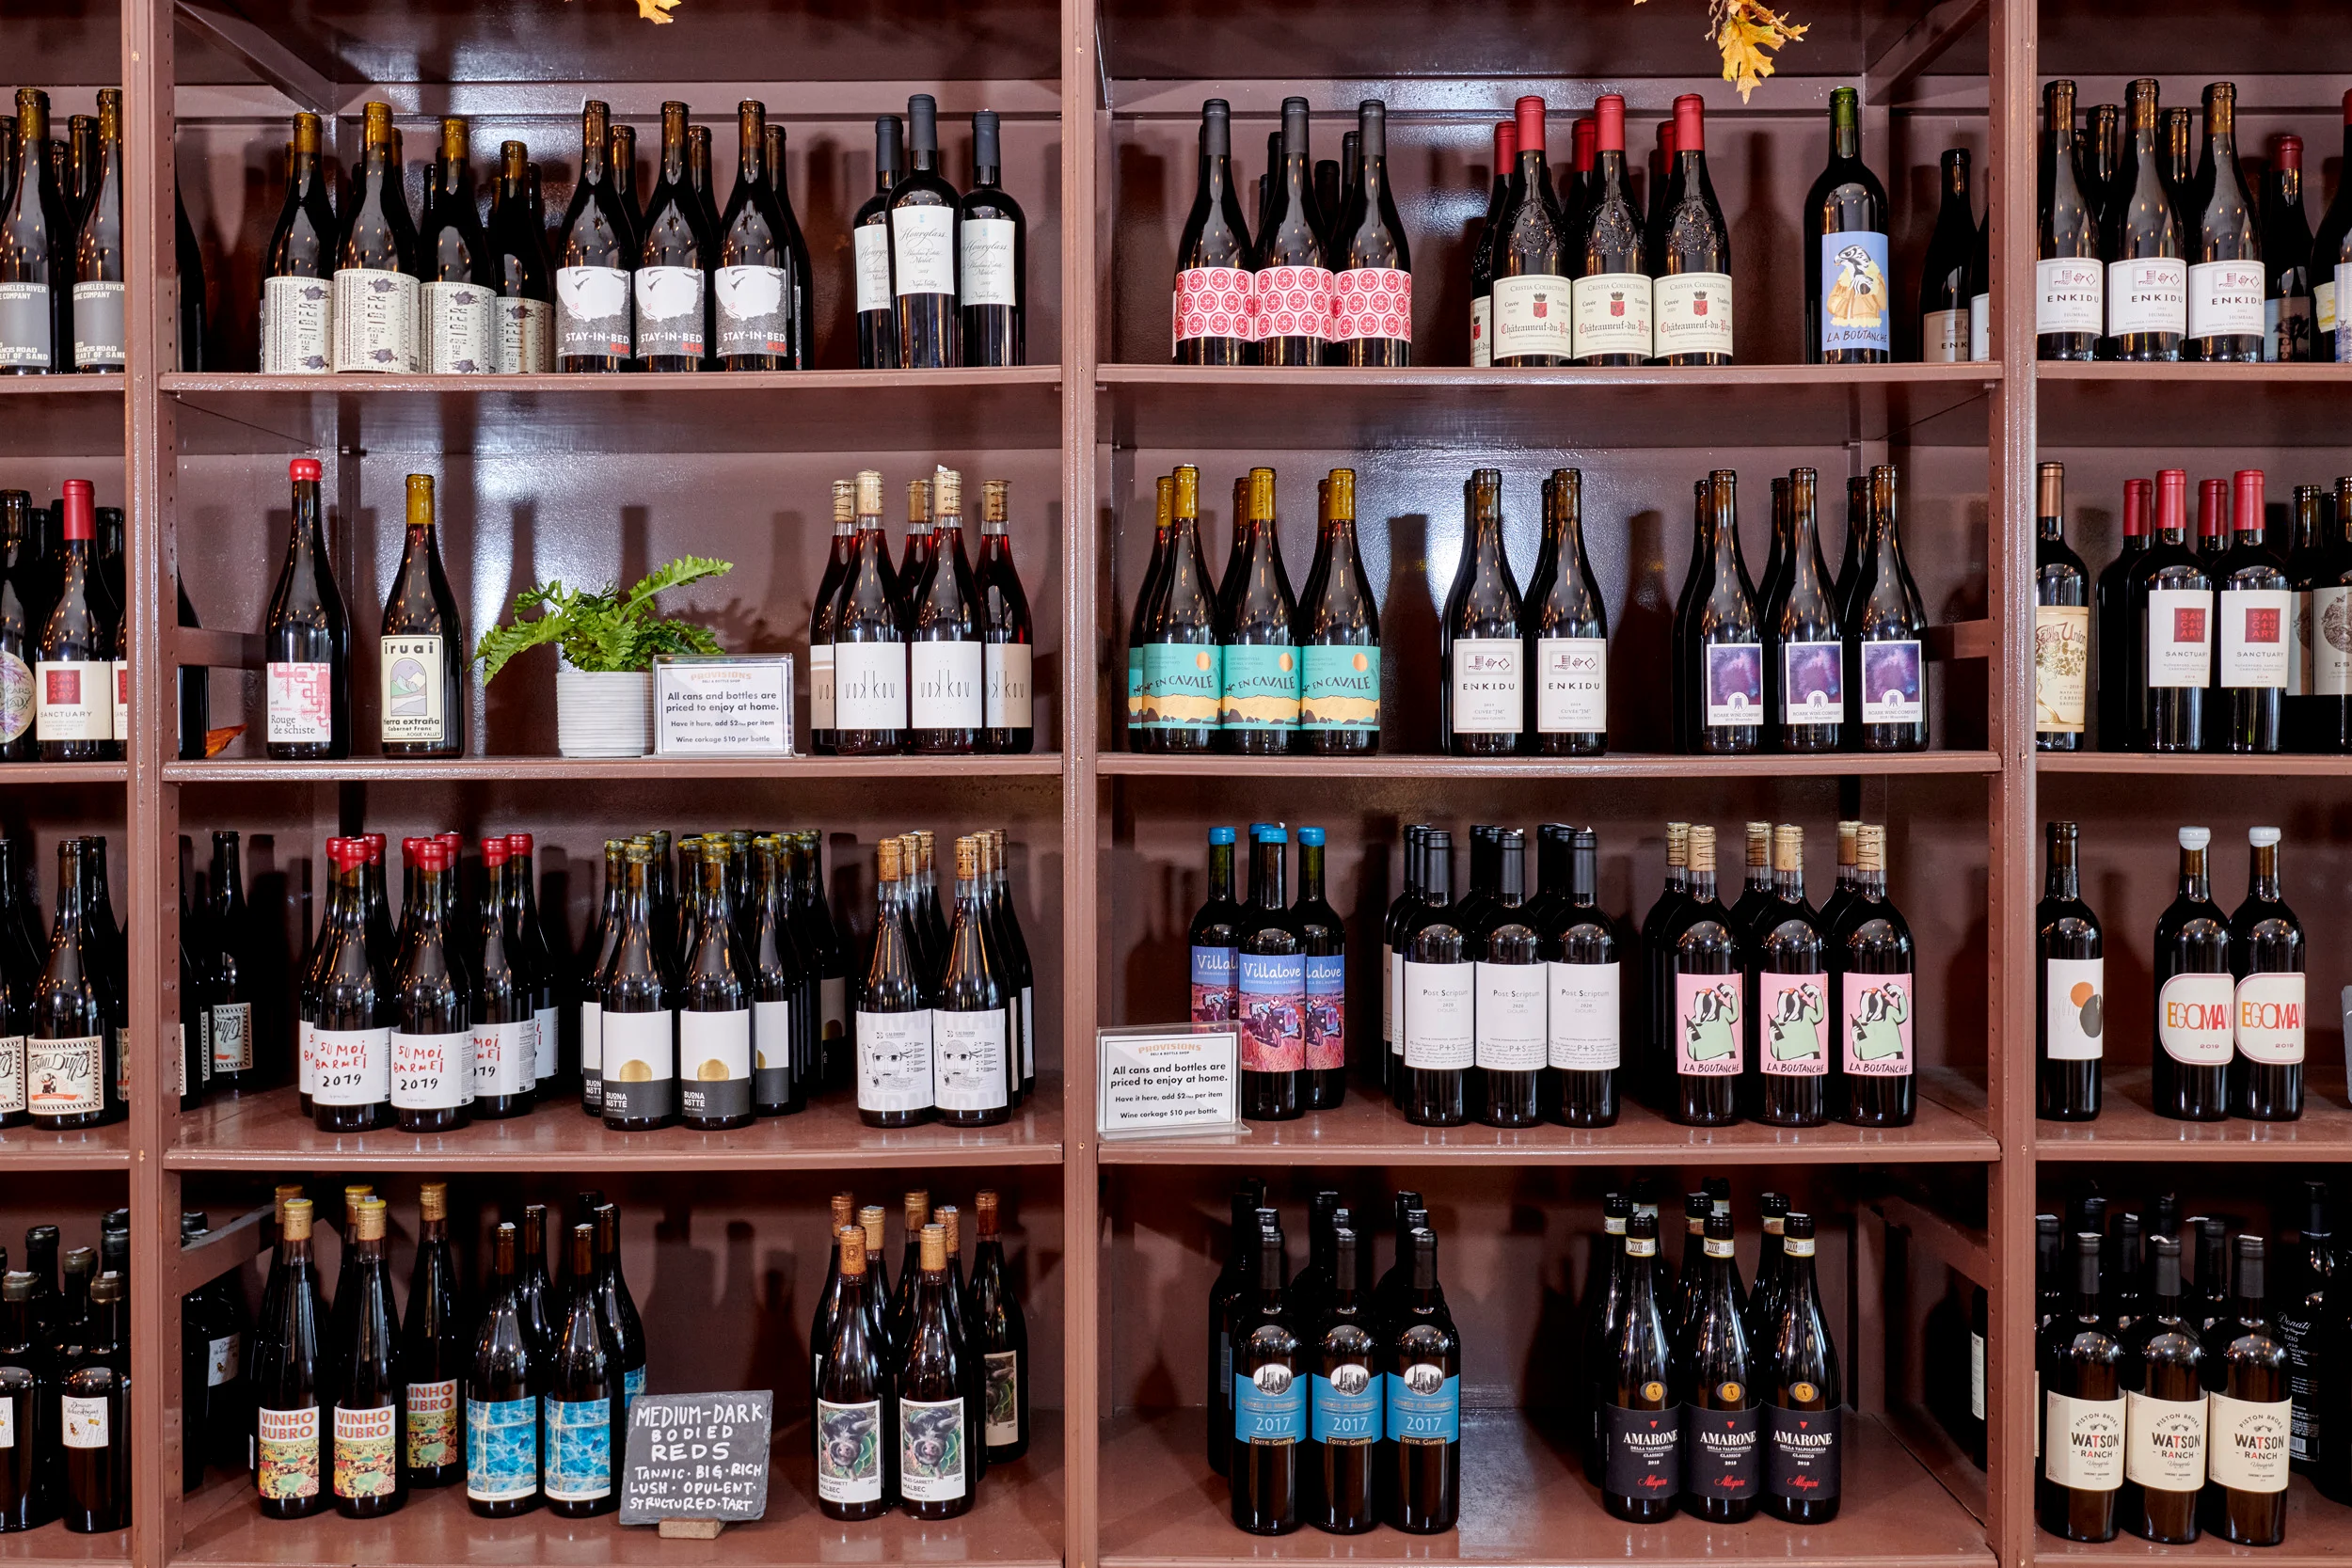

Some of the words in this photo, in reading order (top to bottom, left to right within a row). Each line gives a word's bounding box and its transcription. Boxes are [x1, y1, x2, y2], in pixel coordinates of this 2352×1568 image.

[899, 227, 947, 247] Hourglass
[80, 284, 103, 293] ANGELES
[566, 330, 629, 343] STAY-IN-BED
[641, 331, 703, 343] STAY-IN-BED
[723, 330, 786, 342] STAY-IN-BED
[610, 342, 629, 355] RED
[385, 641, 434, 655] iruai
[50, 674, 74, 683] SAN
[1155, 676, 1167, 689] EN
[1168, 674, 1214, 689] CAVALE
[50, 690, 74, 700] ARY
[706, 691, 723, 700] and
[726, 690, 757, 700] bottles
[666, 704, 693, 714] priced
[709, 704, 735, 713] enjoy
[271, 715, 295, 728] Rouge
[274, 725, 282, 735] de
[284, 725, 315, 735] schiste
[1197, 955, 1238, 970] Villal
[1244, 963, 1301, 978] Villalove
[1307, 963, 1342, 978] lalove
[1493, 990, 1509, 998] Post
[1511, 990, 1540, 998] Scriptum
[1580, 990, 1610, 998] Scriptum
[1138, 1043, 1202, 1053] PROVISIONS
[1113, 1066, 1125, 1075] All
[1153, 1064, 1171, 1073] and
[1175, 1063, 1207, 1072] bottles
[1683, 1062, 1695, 1071] LA
[1697, 1063, 1740, 1073] BOUTANCHE
[1767, 1062, 1778, 1071] LA
[1781, 1063, 1824, 1073] BOUTANCHE
[323, 1073, 362, 1087] 2019
[400, 1078, 438, 1090] 2019
[586, 1079, 601, 1087] BUON
[1111, 1077, 1140, 1089] priced
[1144, 1077, 1152, 1085] to
[1156, 1076, 1183, 1086] enjoy
[1199, 1074, 1228, 1083] home.
[606, 1091, 627, 1100] BUONA
[2278, 1311, 2311, 1330] Donati
[410, 1384, 454, 1398] INHO
[408, 1397, 453, 1412] UBRO
[262, 1412, 314, 1426] VINHO
[337, 1410, 391, 1424] VINHO
[636, 1403, 763, 1428] MEDIUM-DARK
[2075, 1413, 2099, 1427] PISTON
[337, 1424, 390, 1439] RUBRO
[1256, 1417, 1291, 1432] 2017
[1333, 1417, 1369, 1432] 2017
[1406, 1417, 1442, 1432] 2017
[262, 1425, 314, 1439] RUBRO
[651, 1425, 733, 1443] BODIED
[1623, 1430, 1678, 1445] AMARONE
[1700, 1430, 1756, 1446] AMARONE
[1773, 1430, 1832, 1446] AMARONE
[1250, 1437, 1270, 1446] Torre
[1272, 1437, 1295, 1446] Guelfa
[2071, 1433, 2120, 1449] WATSON
[2152, 1433, 2201, 1449] WATSON
[2234, 1433, 2284, 1449] WATSON
[651, 1442, 730, 1462] REDS
[2080, 1449, 2113, 1459] RANCH
[2161, 1449, 2194, 1459] RANCH
[2244, 1450, 2278, 1460] RANCH
[903, 1483, 926, 1493] MALBEC
